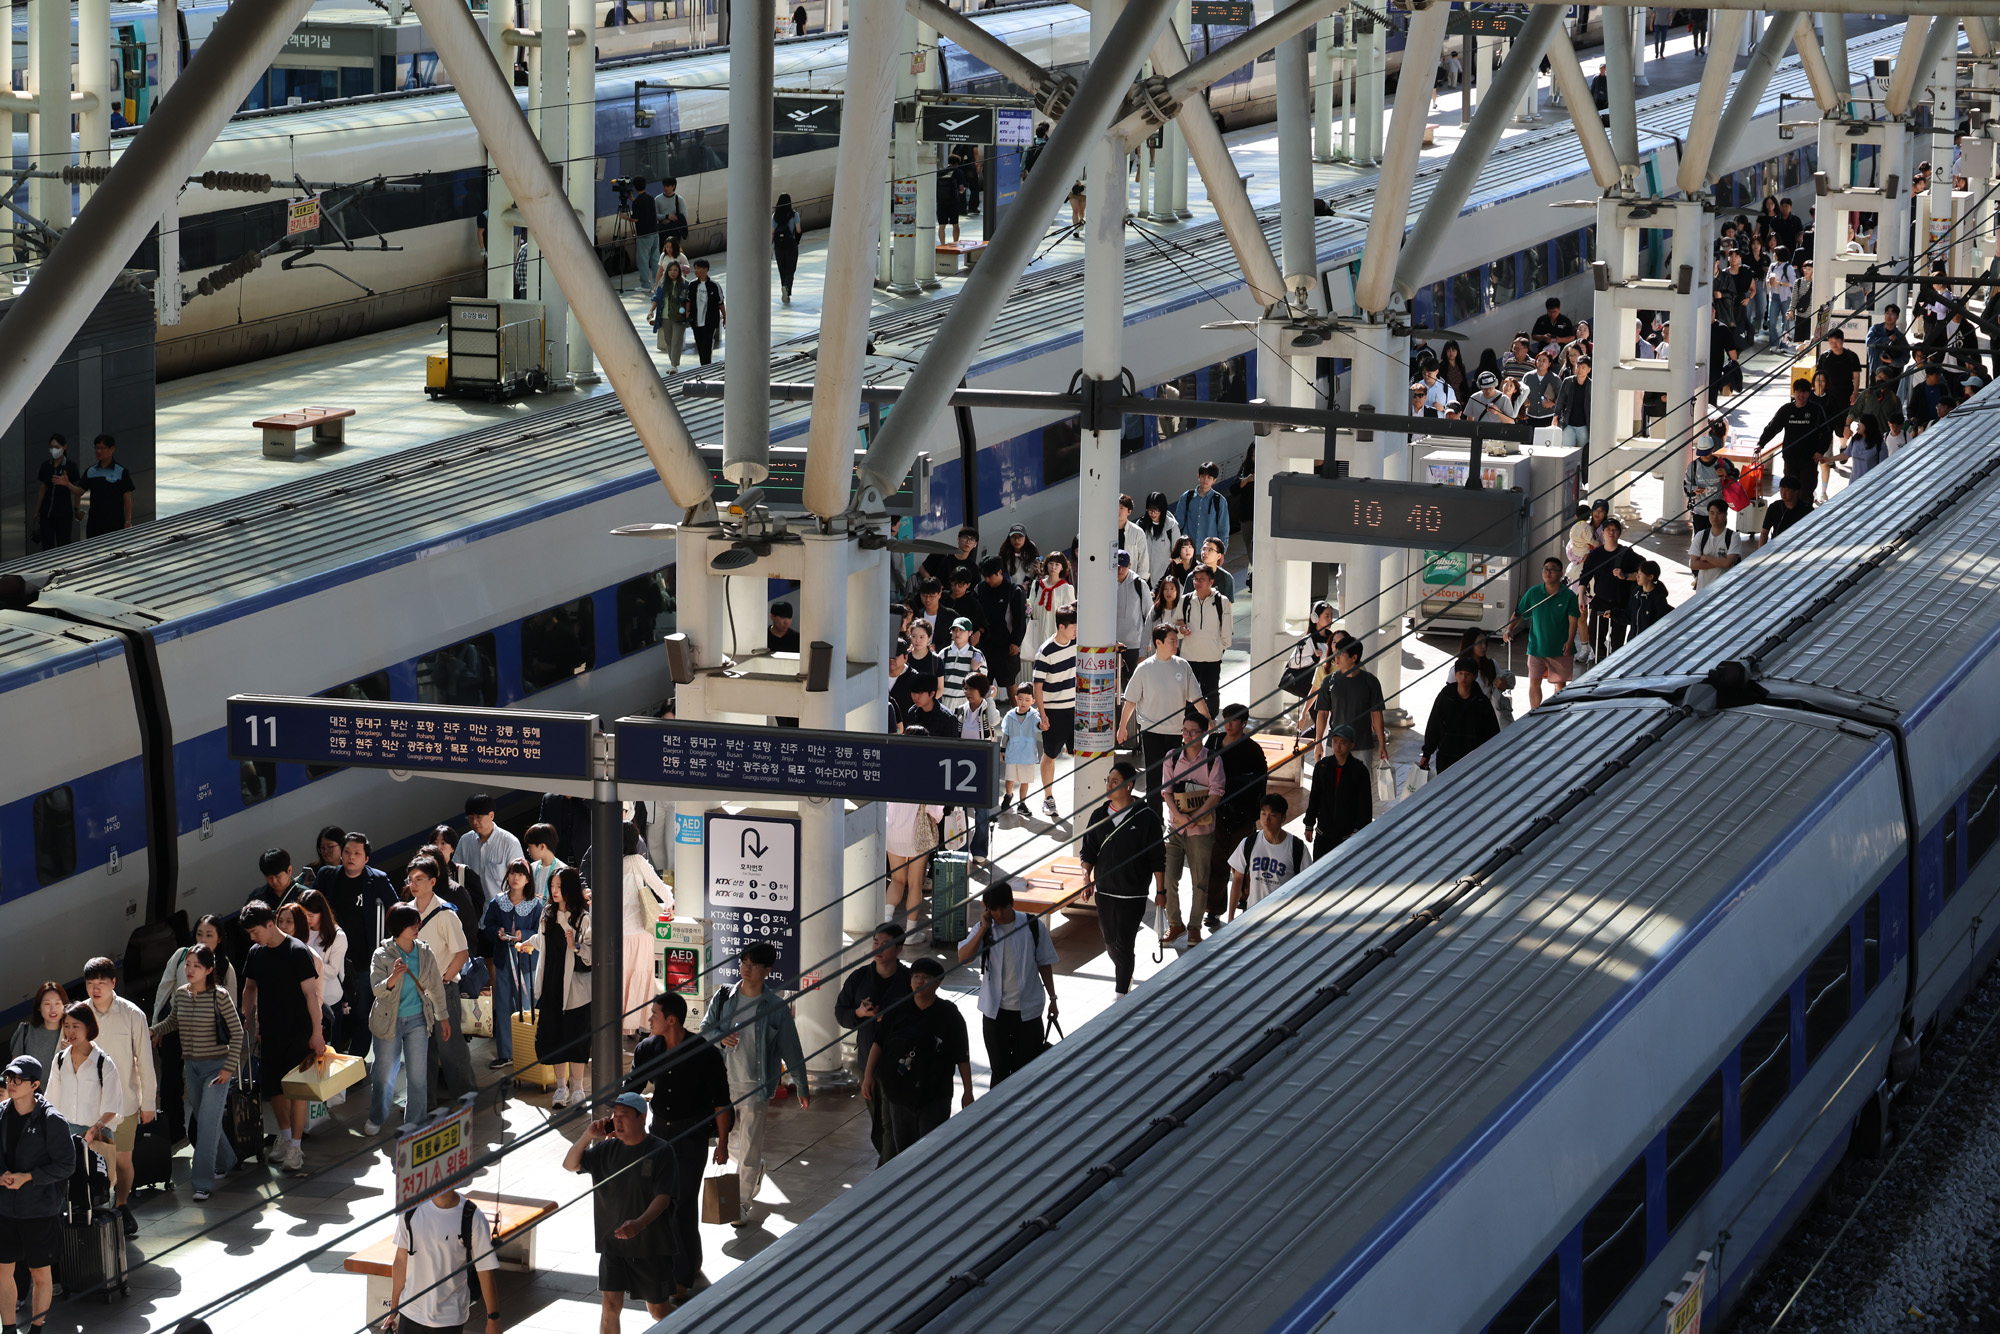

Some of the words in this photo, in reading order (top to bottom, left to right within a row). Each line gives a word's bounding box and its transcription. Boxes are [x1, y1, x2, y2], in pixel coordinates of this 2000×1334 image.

[285, 34, 331, 48] 객대기실
[1353, 500, 1382, 526] 10
[1407, 504, 1442, 532] 40
[1436, 588, 1485, 601] Storyay
[246, 715, 277, 747] 11
[330, 716, 346, 727] 대전
[355, 718, 381, 729] 동대구
[391, 720, 408, 730] 부산
[416, 721, 434, 732] 포항
[443, 722, 460, 733] 진주
[470, 724, 487, 735] 마산
[496, 726, 513, 737] 강릉
[523, 727, 540, 738] 동해
[330, 737, 346, 748] 안동
[355, 738, 372, 749] 원주
[382, 740, 399, 751] 익산
[407, 741, 442, 754] 광주송정
[451, 744, 468, 754] 목포
[477, 745, 519, 757] 여수EXPO
[523, 748, 540, 759] 방면
[663, 735, 680, 746] 대전
[690, 737, 717, 748] 동대구
[726, 740, 744, 750] 부산
[753, 741, 771, 753] 포항
[781, 743, 798, 754] 진주
[808, 745, 826, 756] 마산
[835, 747, 853, 758] 강릉
[863, 749, 880, 760] 동해
[663, 756, 680, 767] 안동
[690, 758, 707, 769] 원주
[717, 760, 734, 771] 익산
[743, 762, 778, 774] 광주송정
[788, 765, 805, 775] 목포
[815, 766, 858, 779] 여수EXPO
[863, 770, 880, 781] 방면
[939, 758, 977, 792] 12
[203, 819, 210, 831] 10
[682, 818, 700, 829] AED
[1252, 856, 1286, 876] 2003
[710, 911, 739, 920] KTX산천
[720, 936, 740, 945] 승차할
[670, 950, 693, 960] AED
[402, 1167, 428, 1201] 전기
[447, 1146, 468, 1176] 위험
